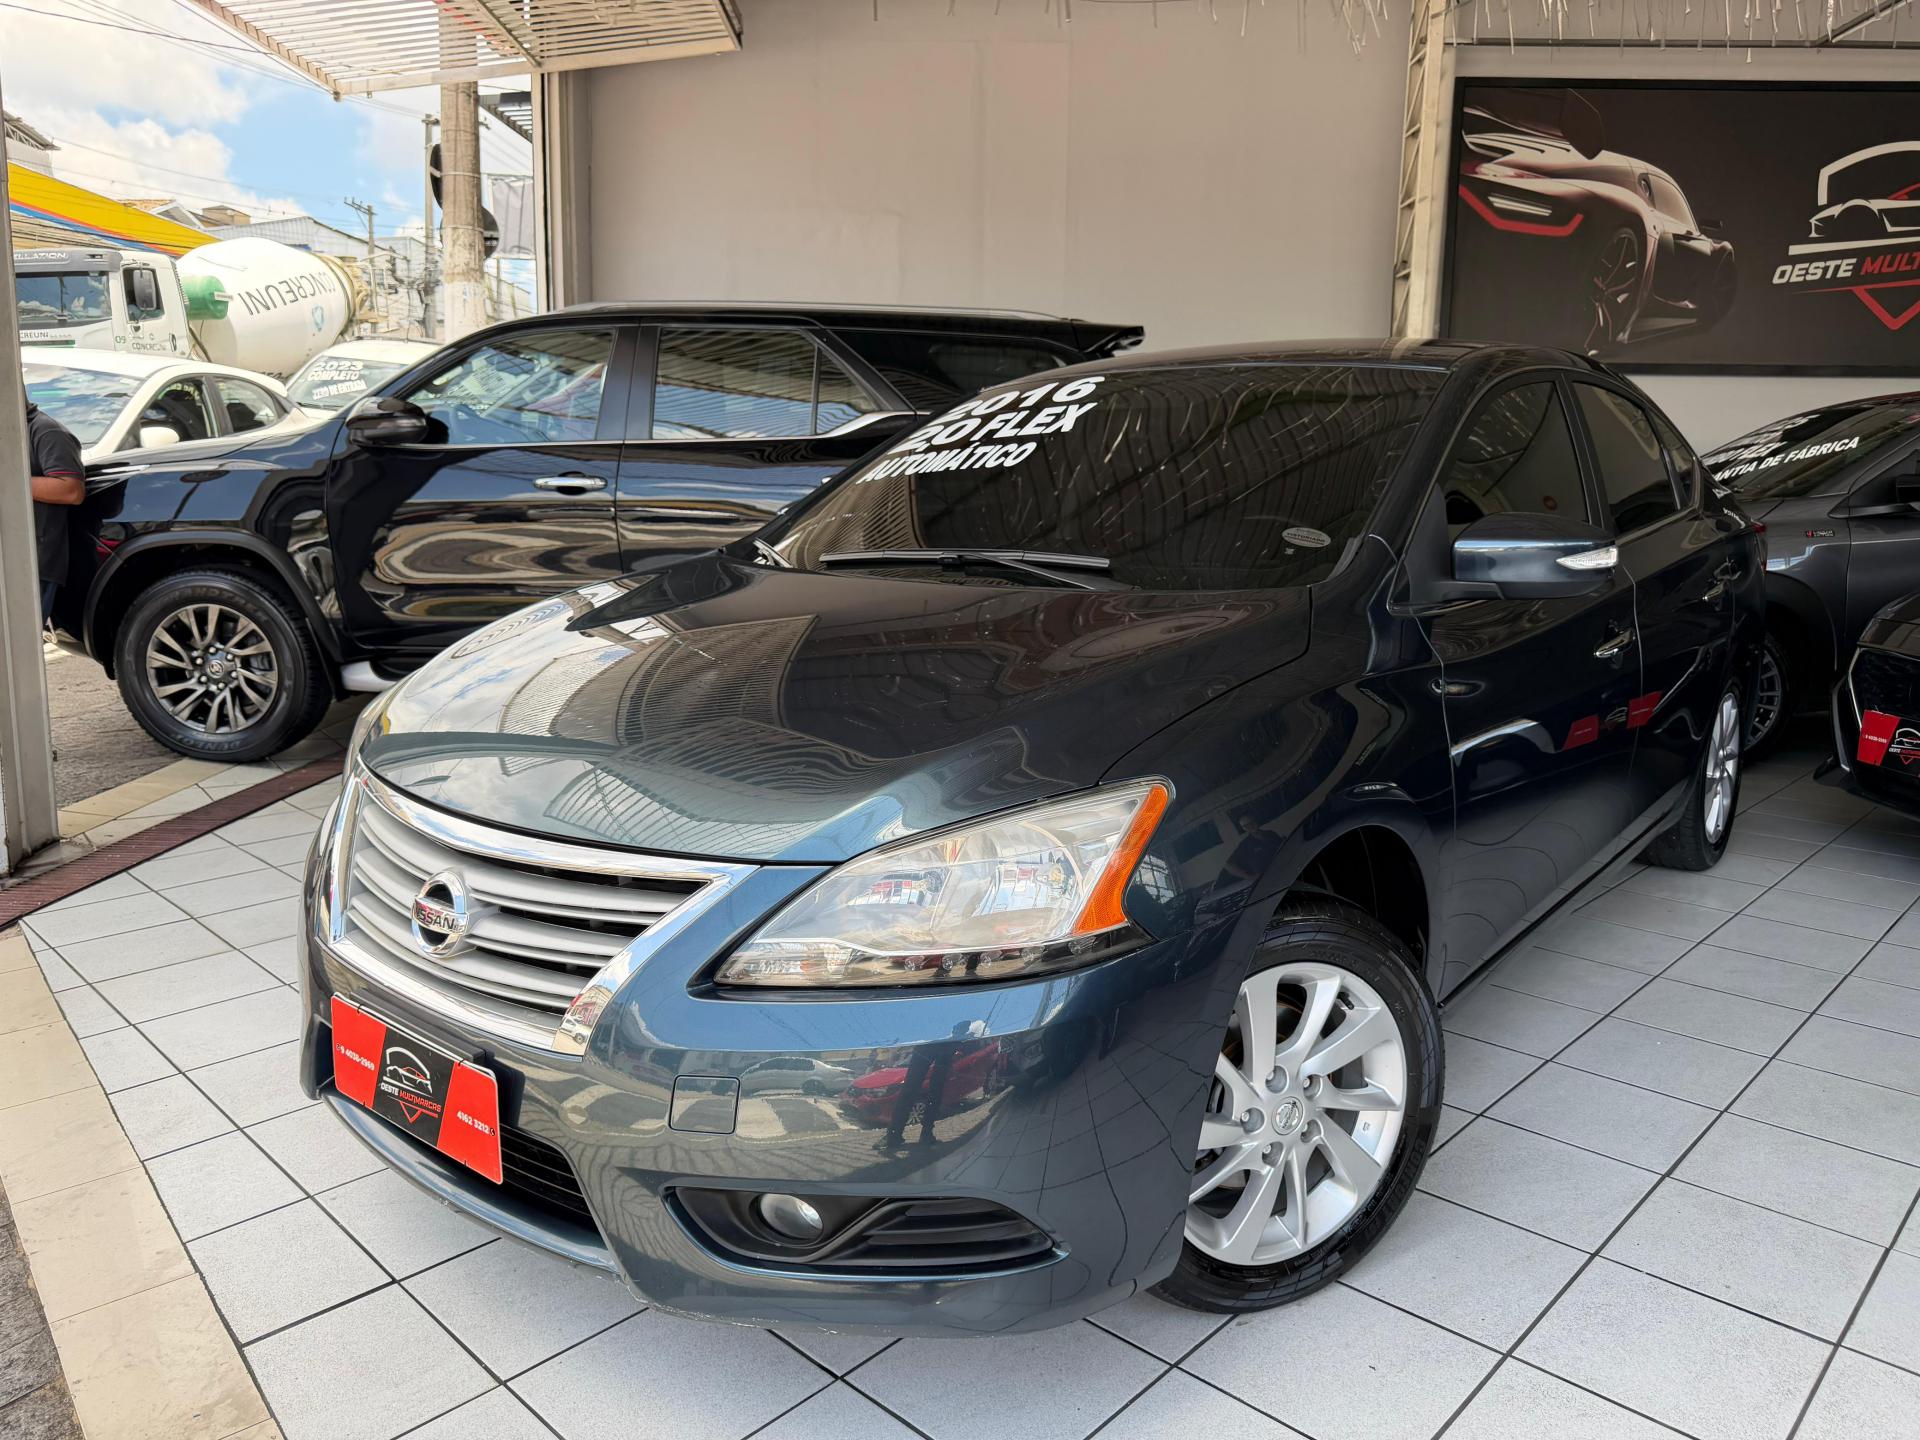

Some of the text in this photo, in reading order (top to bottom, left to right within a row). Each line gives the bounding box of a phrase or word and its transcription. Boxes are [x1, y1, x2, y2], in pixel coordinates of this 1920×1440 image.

[1772, 258, 1857, 285] OESTE
[307, 371, 360, 381] COMPLETO
[314, 361, 364, 371] 2023
[926, 376, 1105, 427] 2016
[969, 402, 1098, 441] FLEX
[855, 441, 1037, 485] AUTOMÁTICO
[1759, 453, 1785, 469] DE
[1784, 436, 1860, 463] FÁBRICA
[380, 1082, 442, 1113] OESTE MULTIMARCAS
